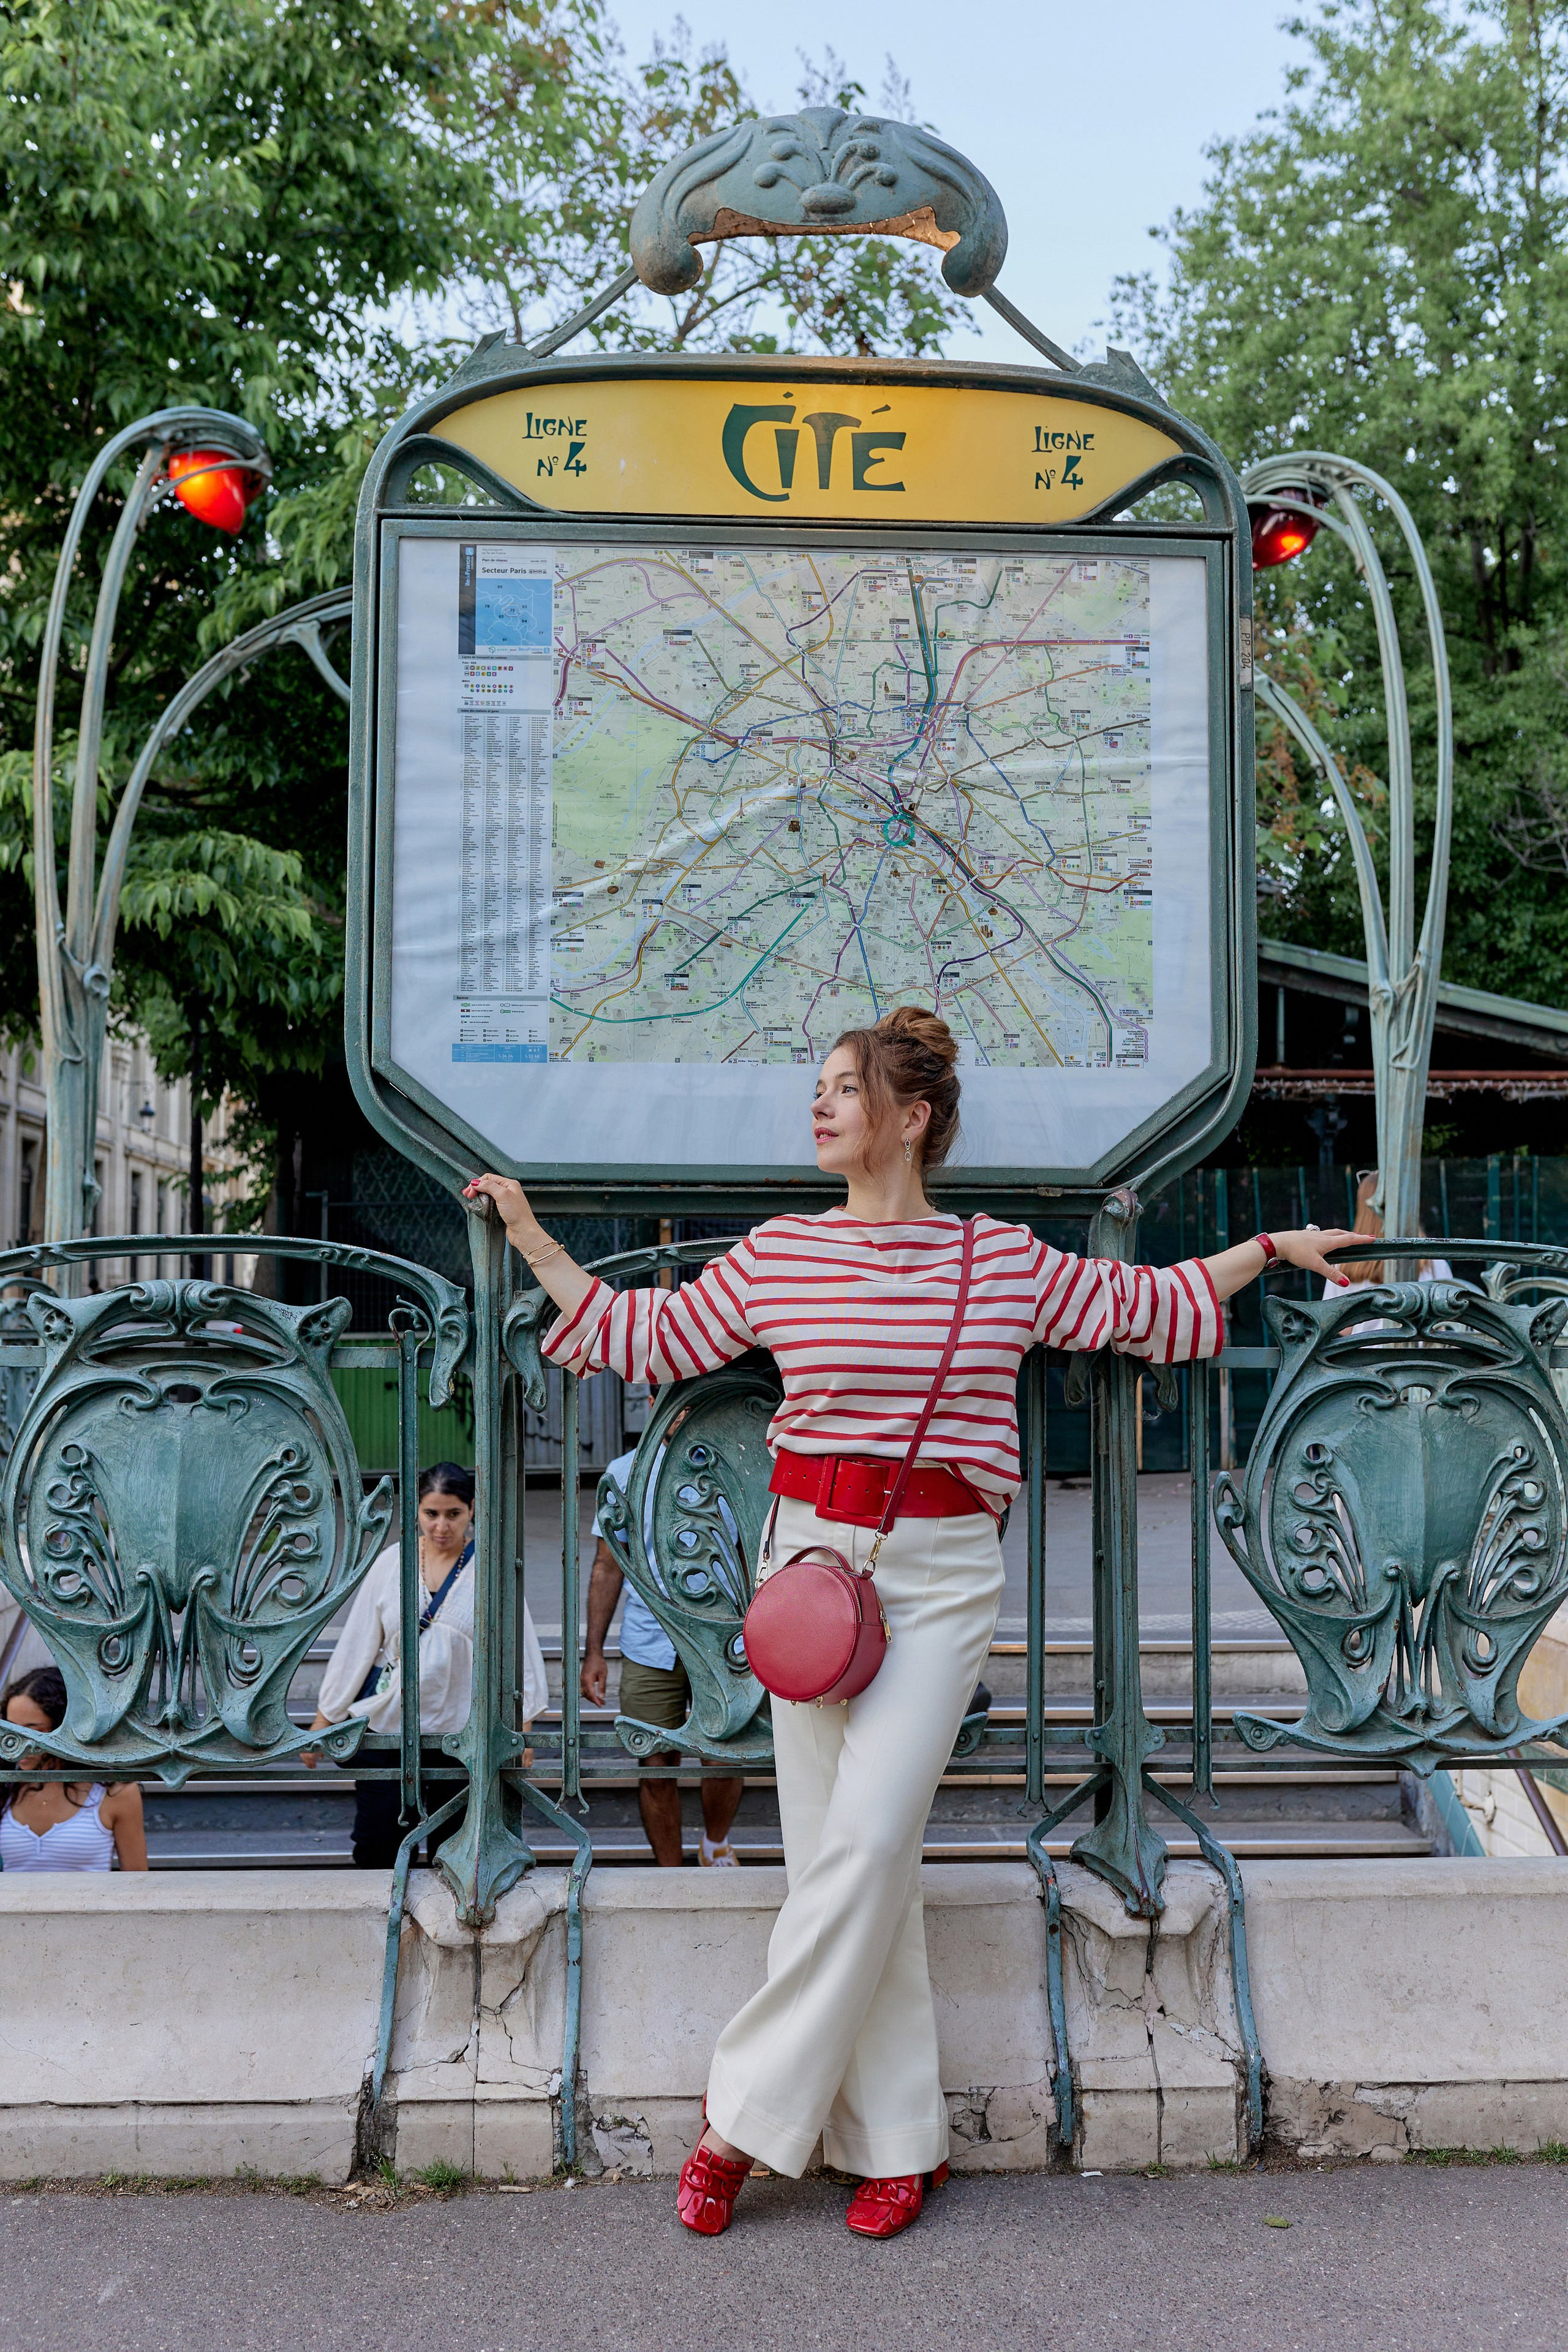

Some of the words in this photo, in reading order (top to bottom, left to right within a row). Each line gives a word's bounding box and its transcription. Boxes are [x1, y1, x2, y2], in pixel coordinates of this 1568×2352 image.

[522, 412, 587, 439] LIGNE
[722, 391, 907, 502] CITÉ
[1031, 426, 1095, 453] LIGNE
[564, 442, 587, 477] 4
[1061, 455, 1084, 490] 4
[1241, 633, 1251, 646] PP
[1241, 652, 1251, 669] 204
